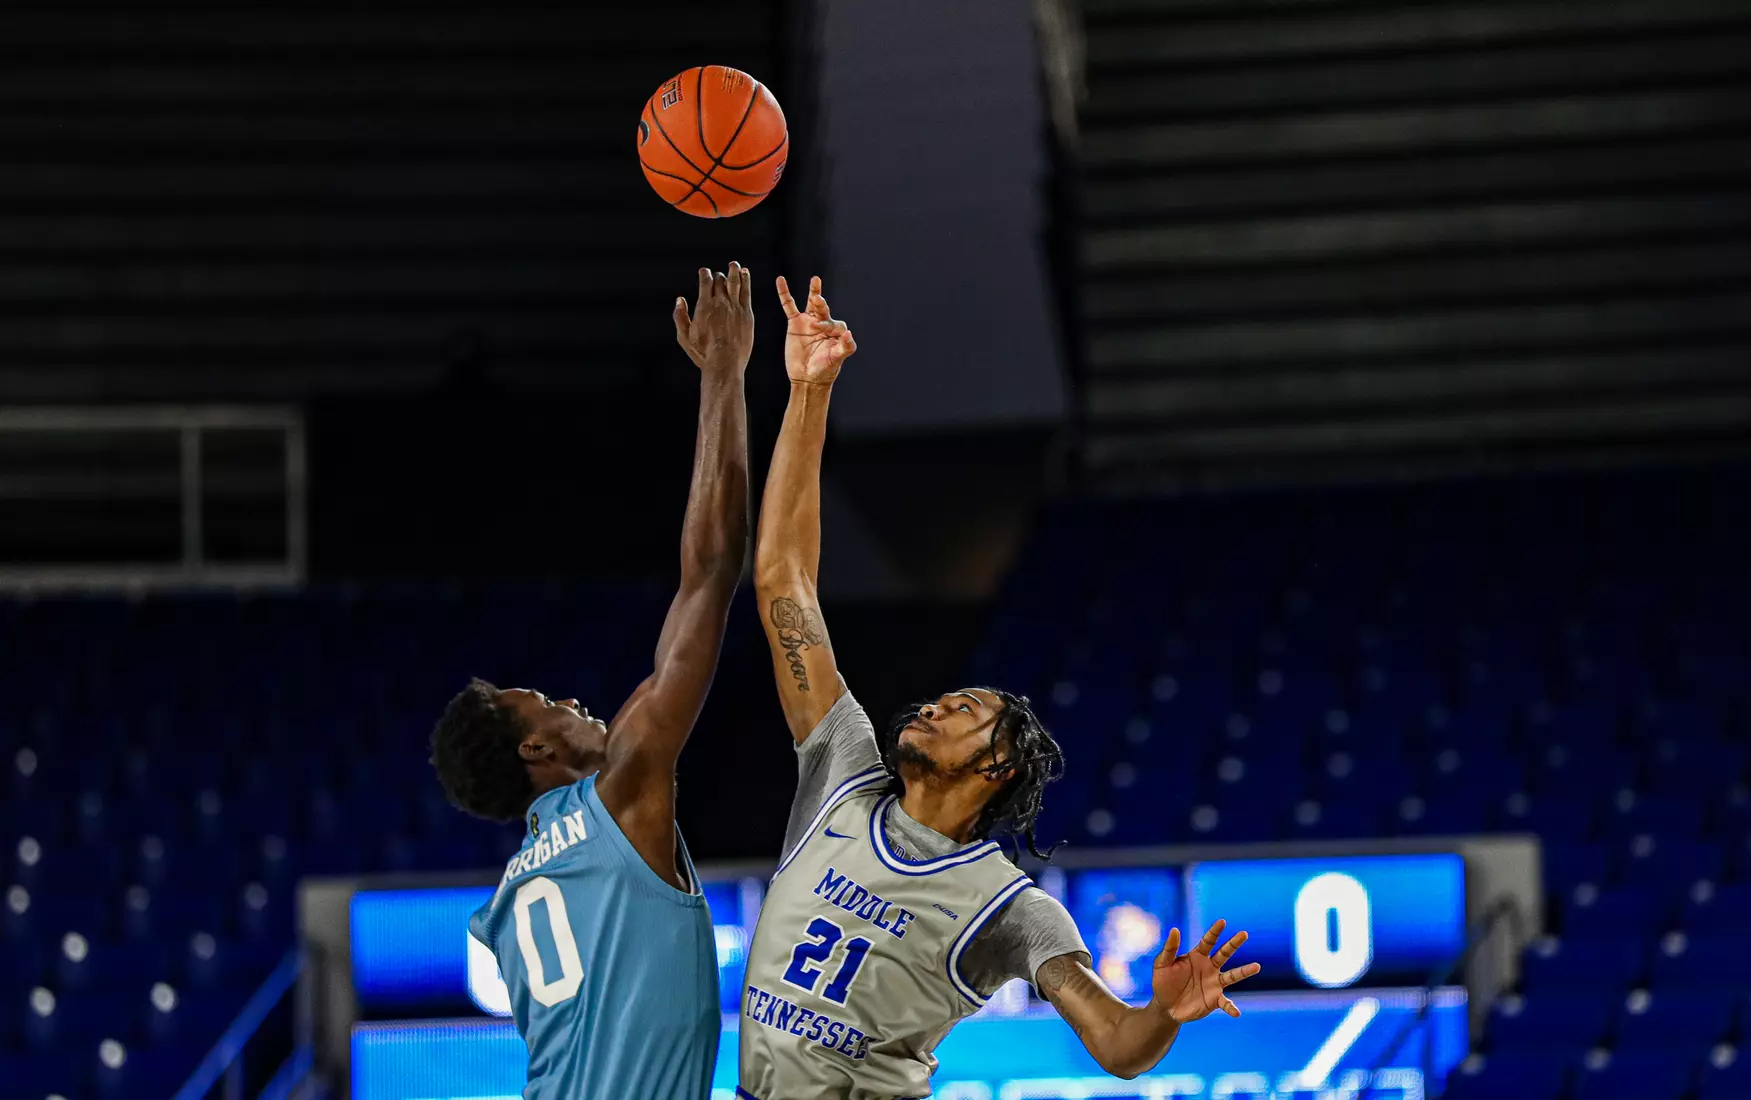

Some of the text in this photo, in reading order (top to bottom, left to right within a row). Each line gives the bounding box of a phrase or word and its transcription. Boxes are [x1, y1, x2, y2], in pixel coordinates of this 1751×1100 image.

[495, 810, 587, 898] RRIGAN
[514, 876, 584, 1007] 0
[812, 866, 916, 940] MIDDLE
[1295, 871, 1373, 988] 0
[780, 915, 875, 1008] 21
